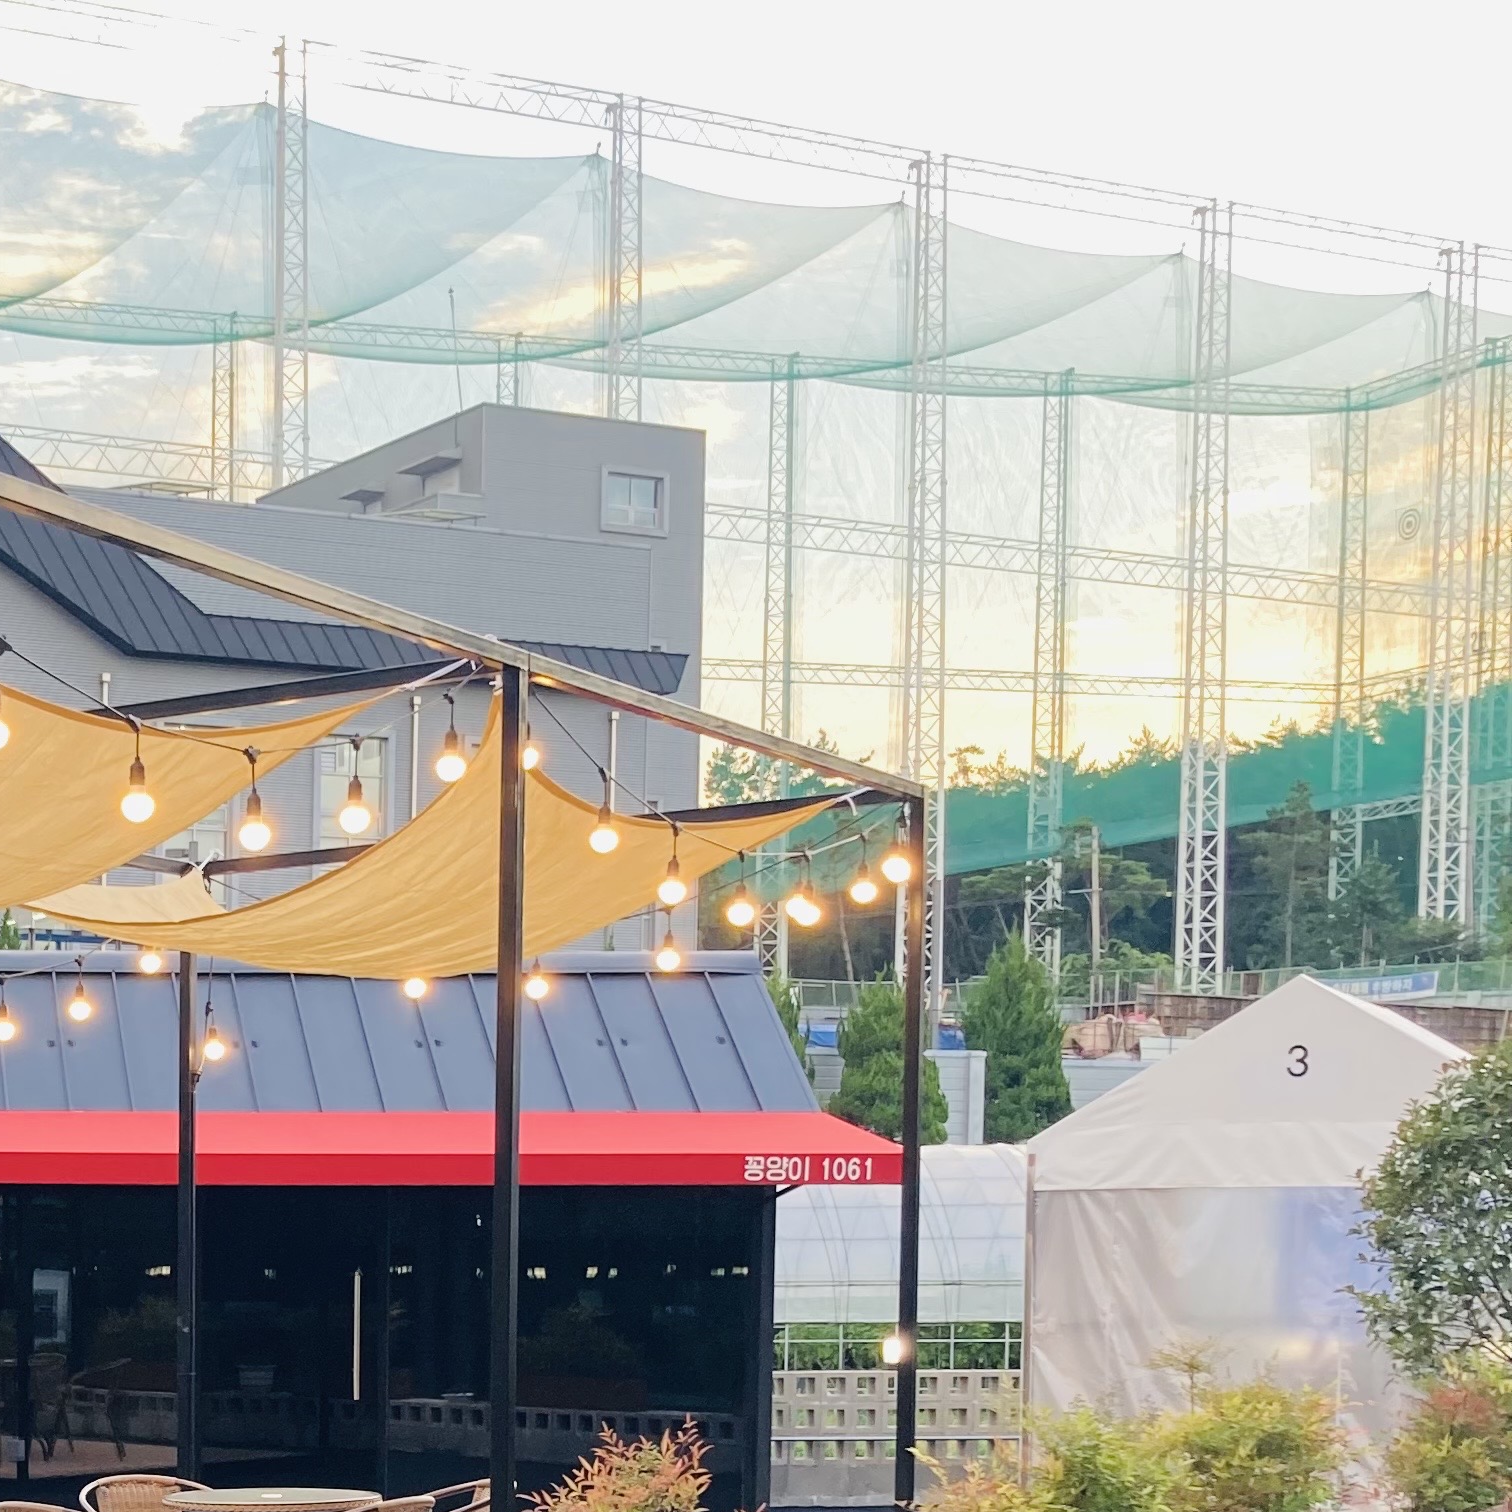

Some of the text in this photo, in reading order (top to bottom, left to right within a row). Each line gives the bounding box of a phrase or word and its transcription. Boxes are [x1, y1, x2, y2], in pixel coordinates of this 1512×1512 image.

[1286, 1044, 1309, 1077] 3
[743, 1155, 874, 1182] 꽁양이 1061
